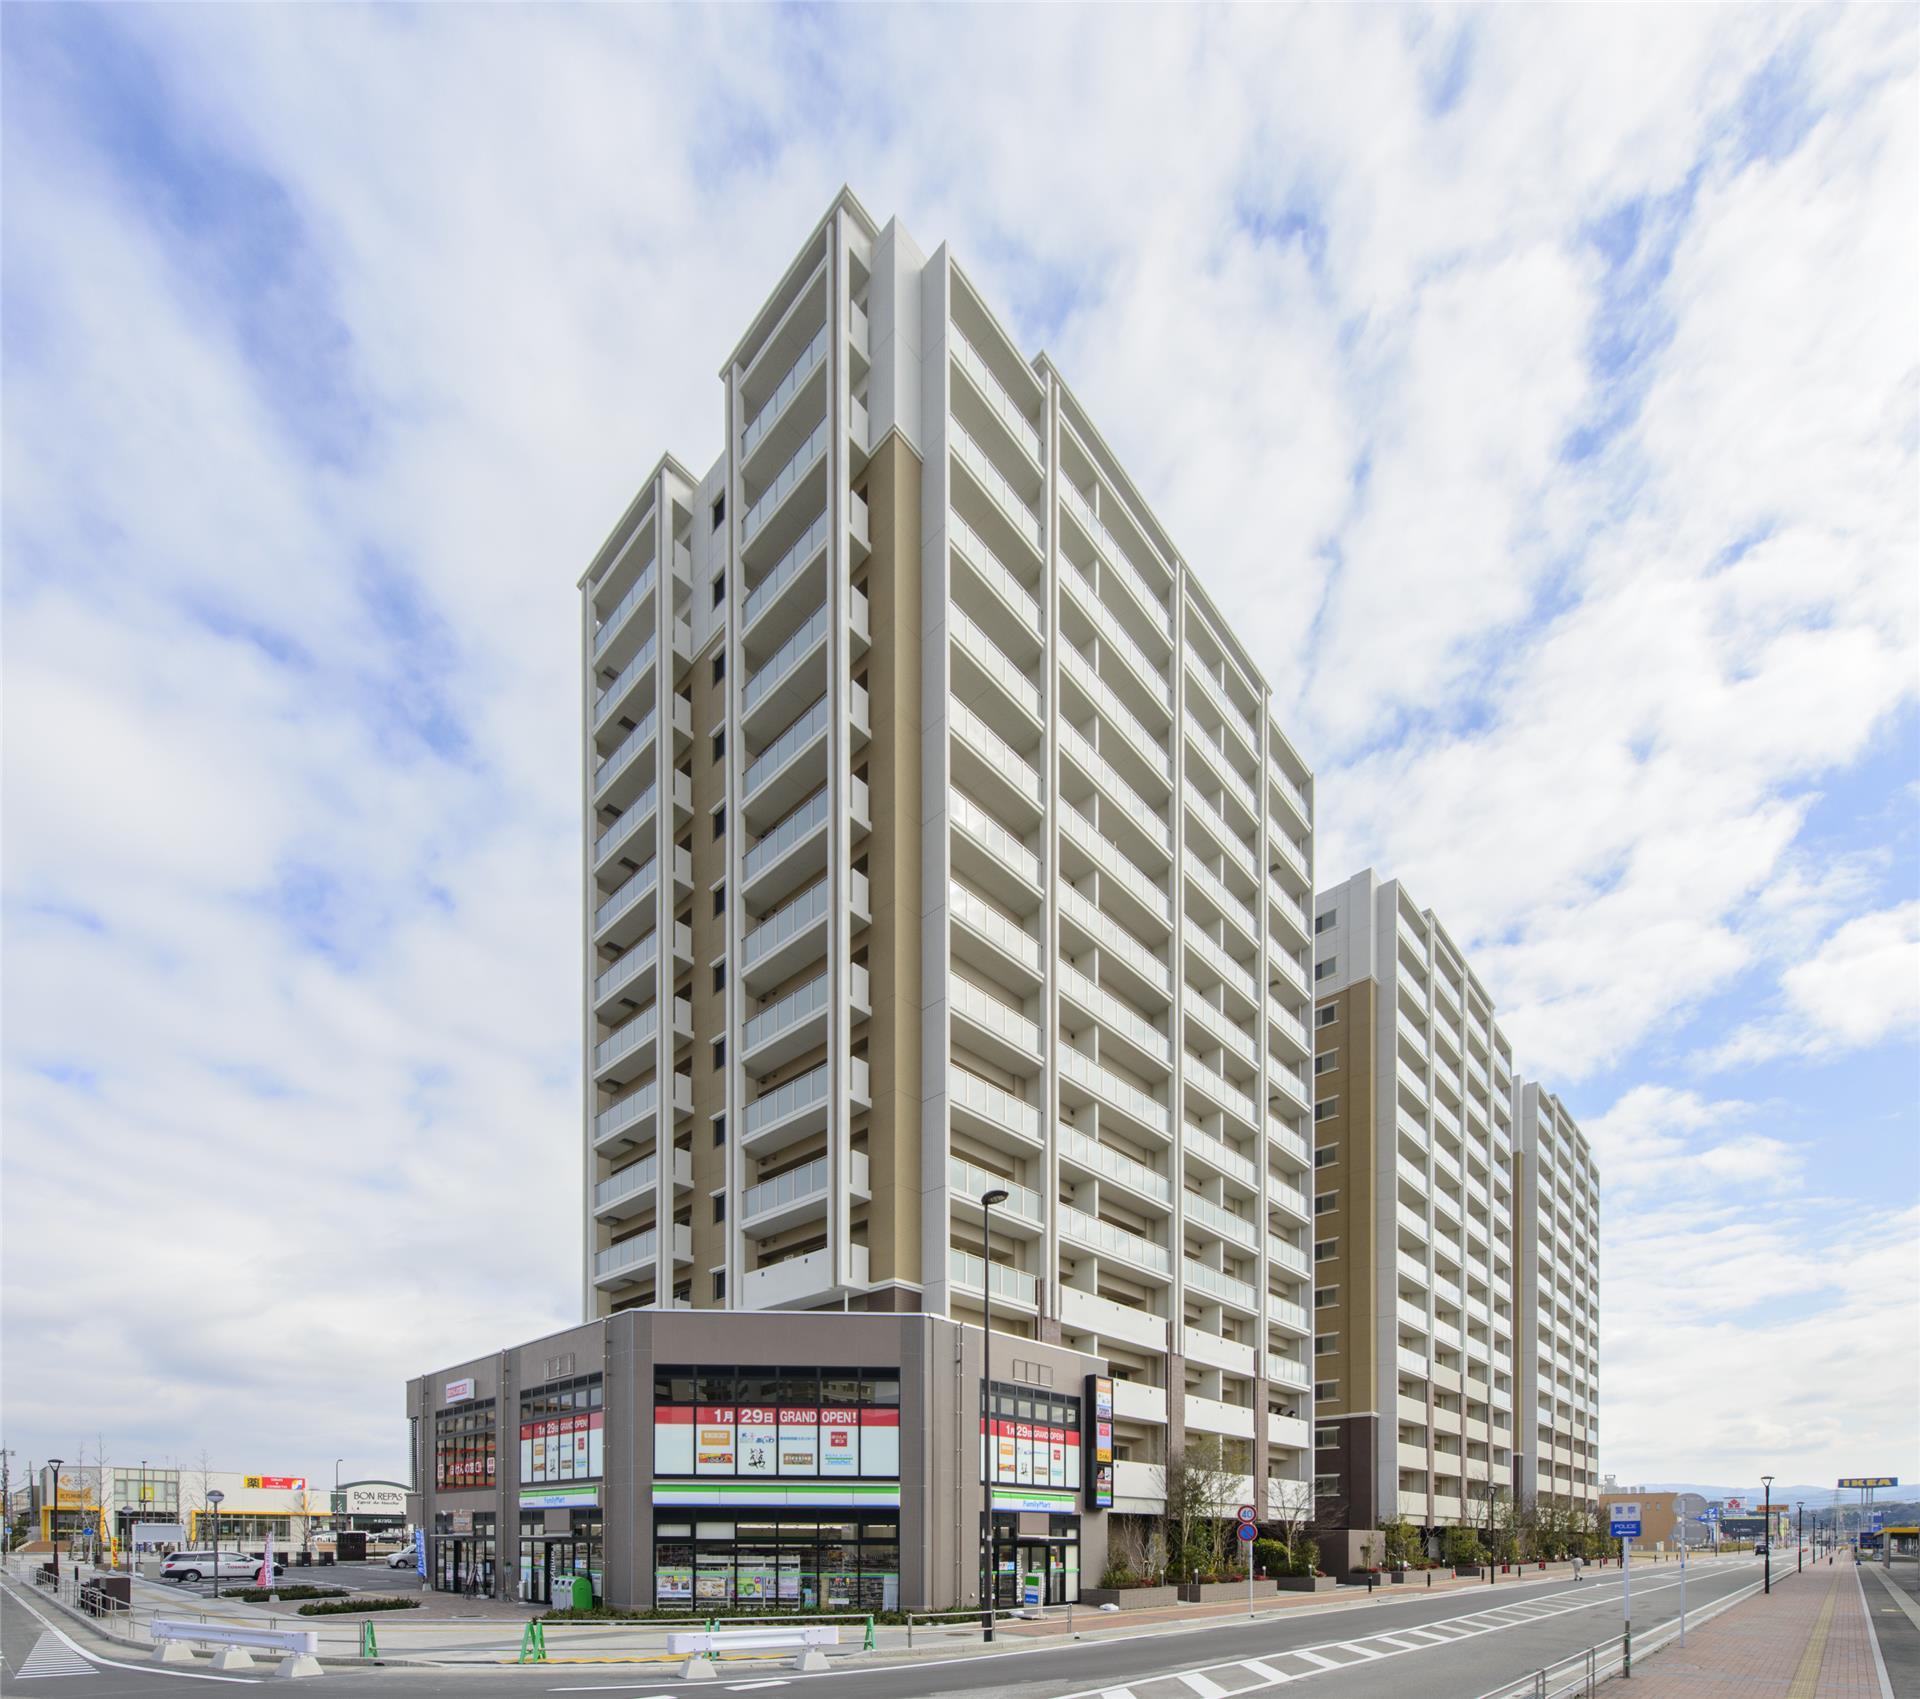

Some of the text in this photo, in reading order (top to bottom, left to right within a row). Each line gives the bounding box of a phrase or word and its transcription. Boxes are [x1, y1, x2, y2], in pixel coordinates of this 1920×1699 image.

[714, 1408, 857, 1423] 1月 29日 GRAND OPEN!
[1843, 1479, 1892, 1487] IKEA
[353, 1491, 403, 1501] BON REPAS
[1023, 1500, 1051, 1510] FamilyMart
[1242, 1510, 1253, 1519] 40
